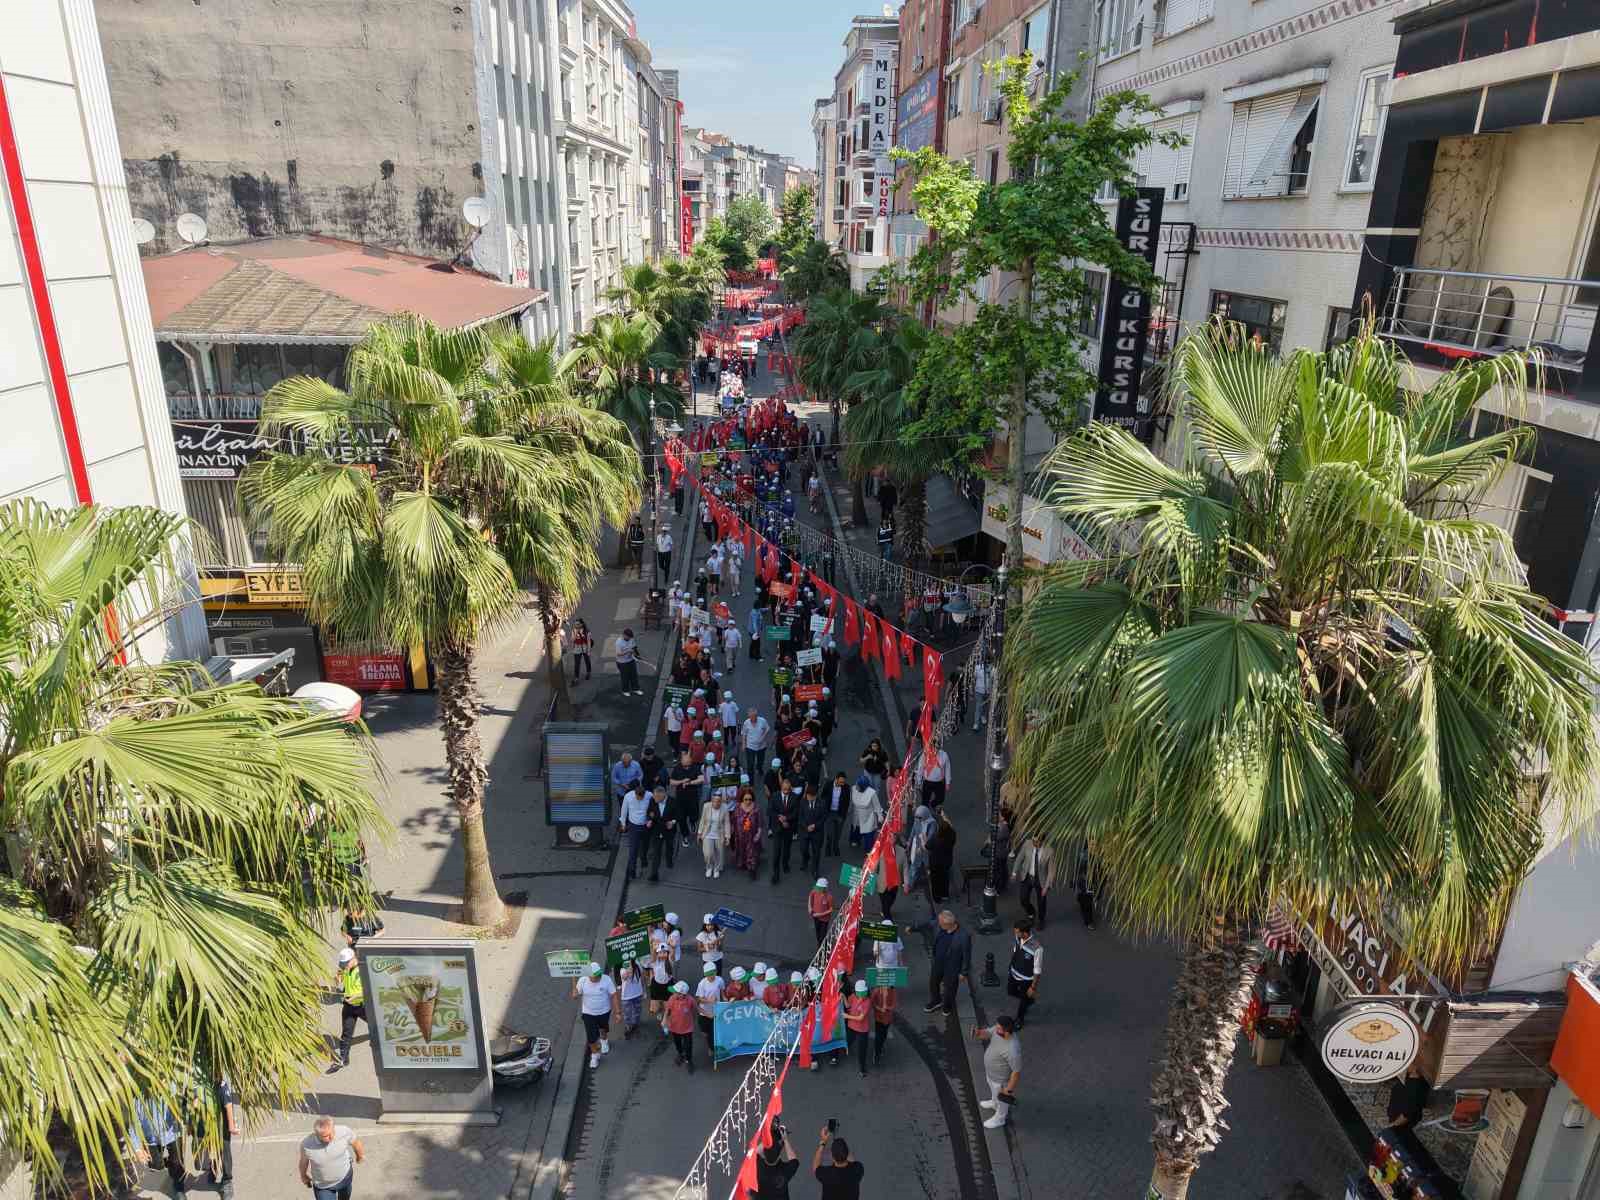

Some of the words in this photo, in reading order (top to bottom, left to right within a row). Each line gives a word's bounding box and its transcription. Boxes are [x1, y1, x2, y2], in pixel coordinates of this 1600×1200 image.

[873, 60, 888, 141] MEDEA
[879, 177, 888, 216] KURS
[1121, 198, 1151, 309] SÜRÜ
[248, 575, 311, 592] EYFE
[395, 1045, 463, 1057] DOUBLE
[1330, 1048, 1383, 1060] HELVACI
[1348, 1063, 1383, 1074] 1900
